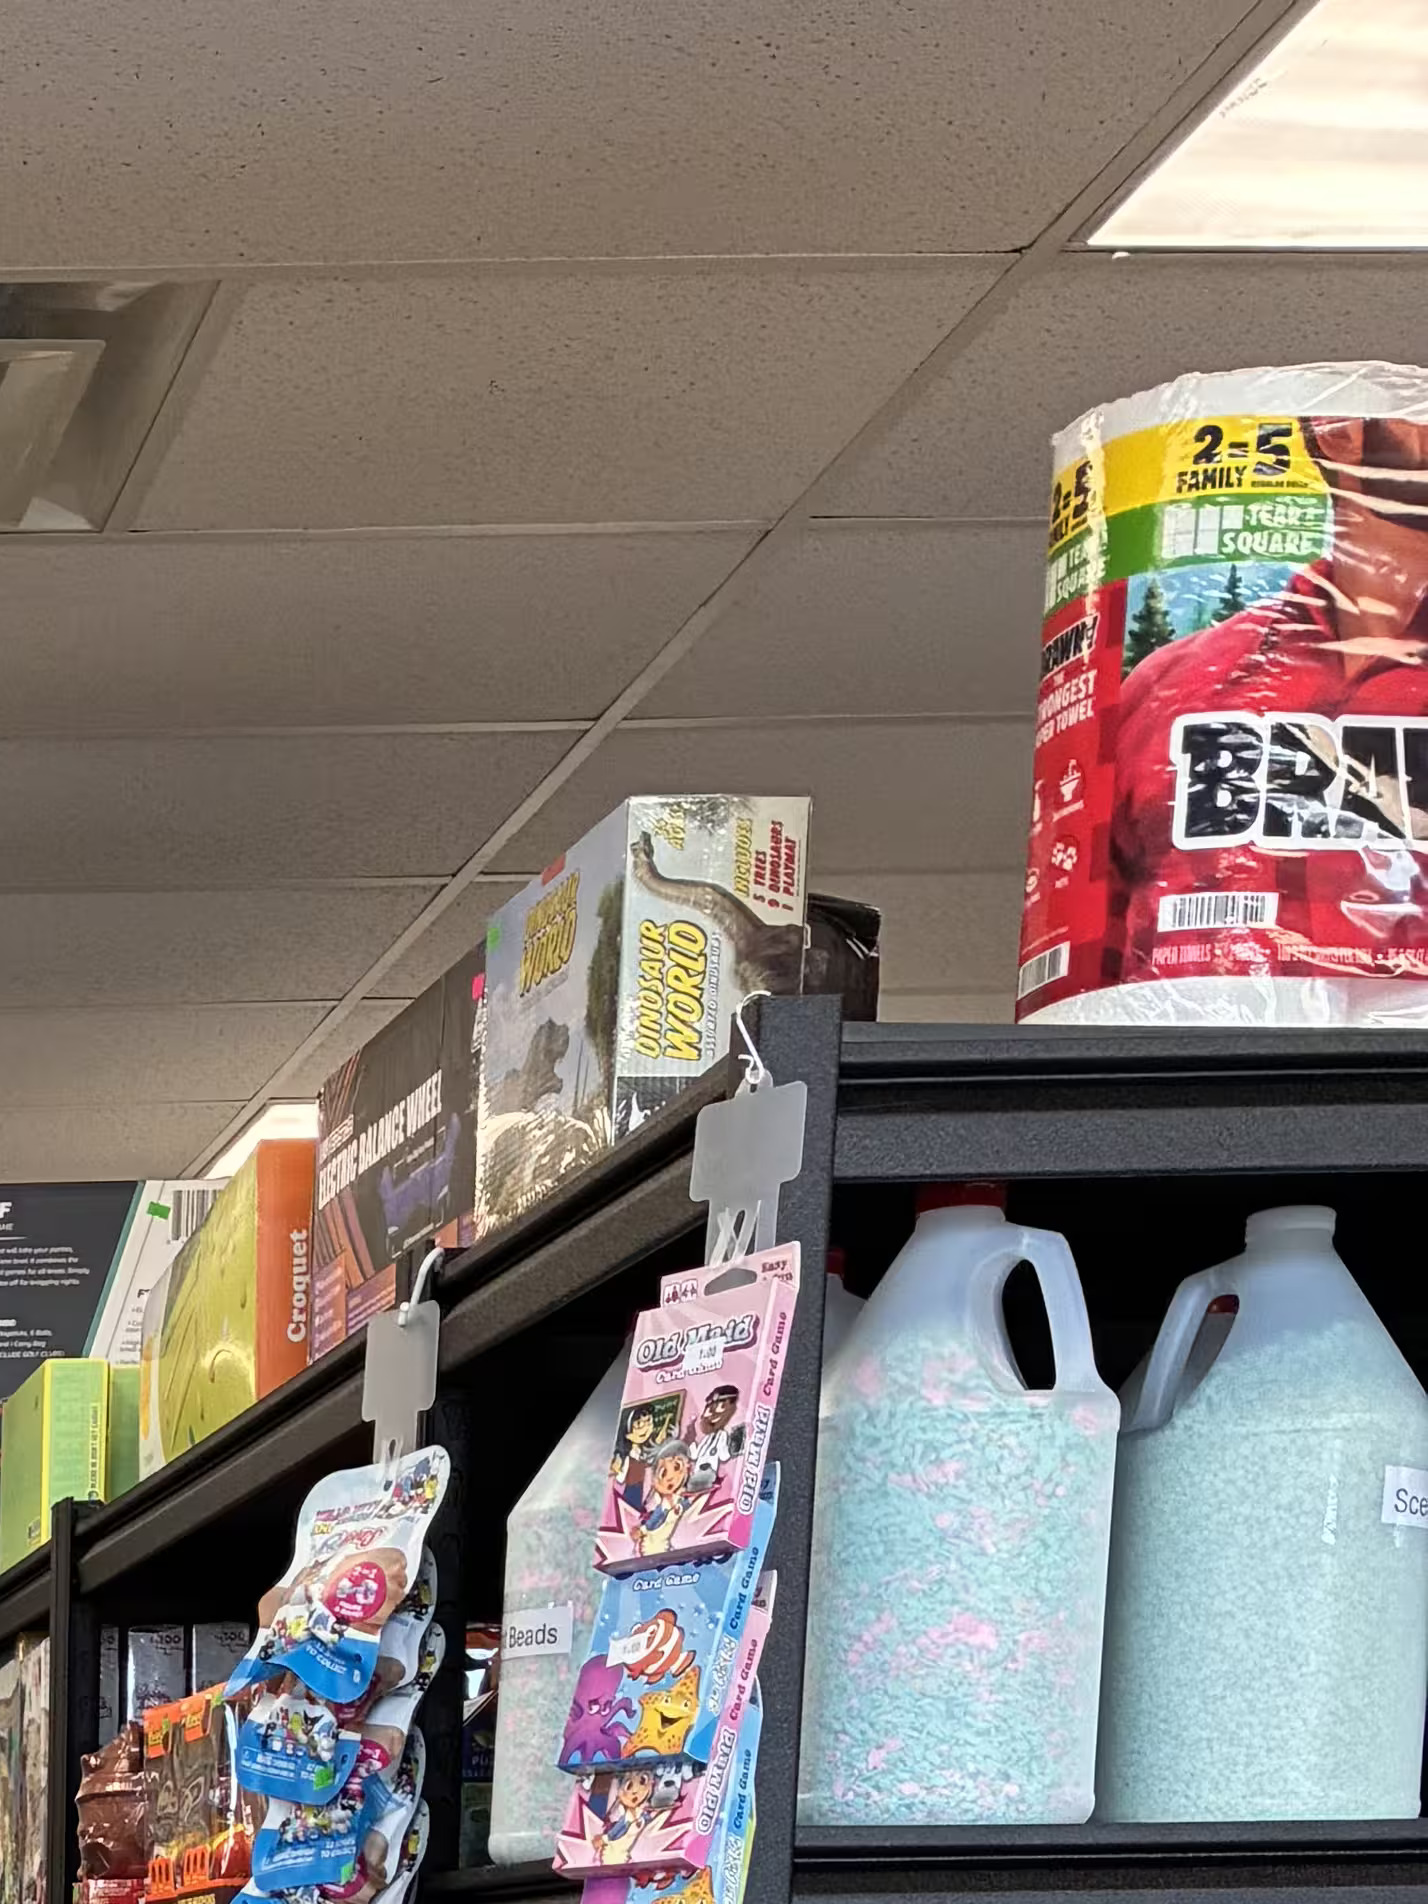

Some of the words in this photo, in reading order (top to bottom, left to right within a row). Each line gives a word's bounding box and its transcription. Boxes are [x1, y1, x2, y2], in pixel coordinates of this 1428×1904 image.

[1176, 467, 1248, 494] FAMILY
[1222, 532, 1322, 556] SQUARE
[754, 850, 767, 888] TREES
[768, 820, 784, 894] DINOSAURS
[781, 837, 798, 899] PLAYMAT
[635, 920, 666, 1060] DINOSAUR
[663, 919, 708, 1061] WORLD
[358, 1100, 406, 1176] BALANCE
[406, 1069, 442, 1139] WHEEL
[287, 1229, 311, 1342] Croquet
[761, 1260, 788, 1273] Easy
[636, 1333, 680, 1365] Old
[738, 1473, 758, 1514] Old
[748, 1406, 771, 1472] Maid
[762, 1359, 779, 1397] Card
[774, 1312, 787, 1356] Game
[729, 1592, 747, 1630] Card
[738, 1546, 760, 1589] Game
[509, 1625, 558, 1650] Beads
[696, 1793, 720, 1836] Old
[708, 1731, 737, 1796] Maid
[729, 1683, 745, 1723] Card
[739, 1636, 759, 1680] Game
[738, 1747, 753, 1790] Game
[733, 1790, 747, 1829] Card
